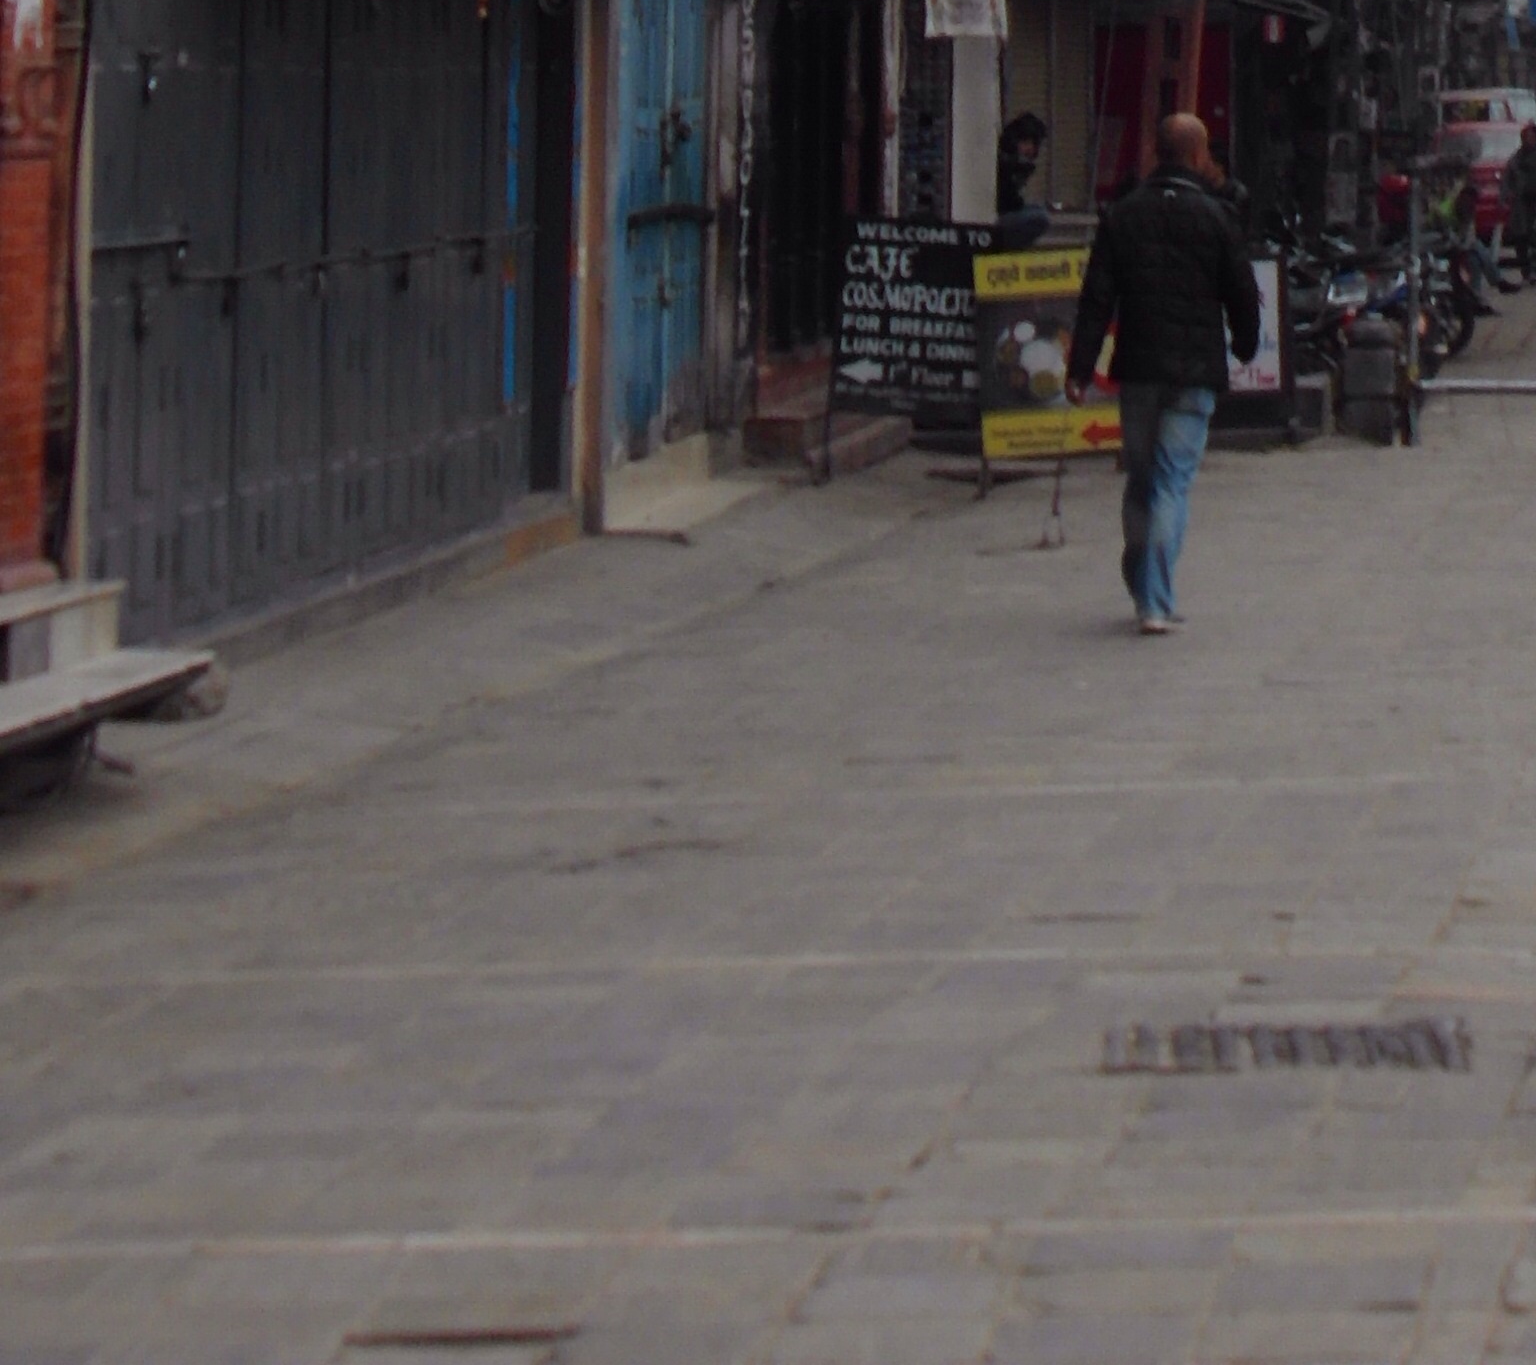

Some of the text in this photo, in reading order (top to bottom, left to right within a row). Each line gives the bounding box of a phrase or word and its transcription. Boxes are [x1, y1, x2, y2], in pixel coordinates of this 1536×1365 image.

[856, 222, 993, 248] WELCOME TO
[842, 313, 976, 340] FOR BREAKFA
[840, 334, 905, 358] LUNCH
